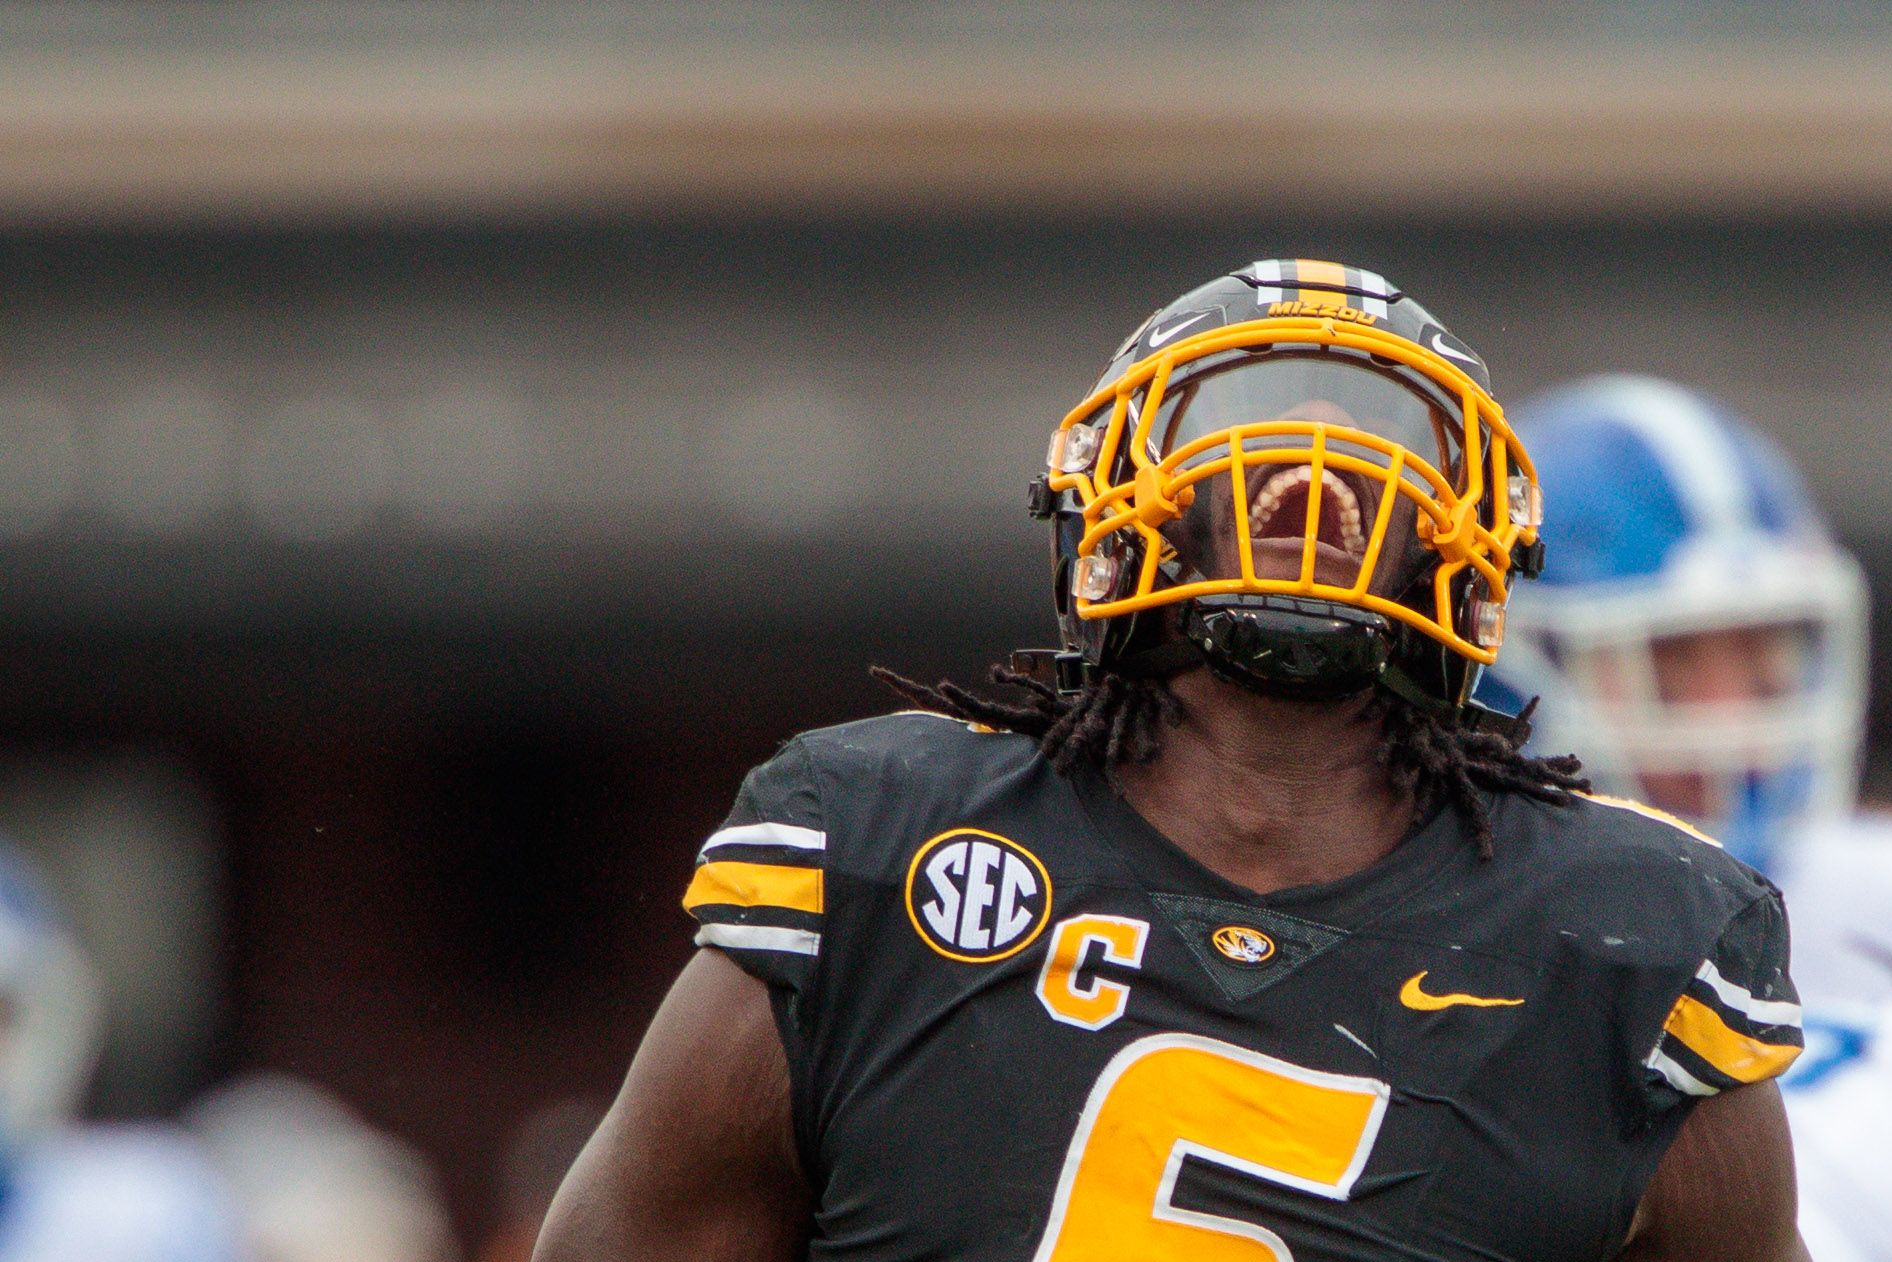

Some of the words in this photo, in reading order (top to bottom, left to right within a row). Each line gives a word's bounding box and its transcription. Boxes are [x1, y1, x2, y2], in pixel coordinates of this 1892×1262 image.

[1268, 299, 1377, 326] MIZZOU
[922, 840, 1037, 949] SEC
[1036, 913, 1150, 1031] C
